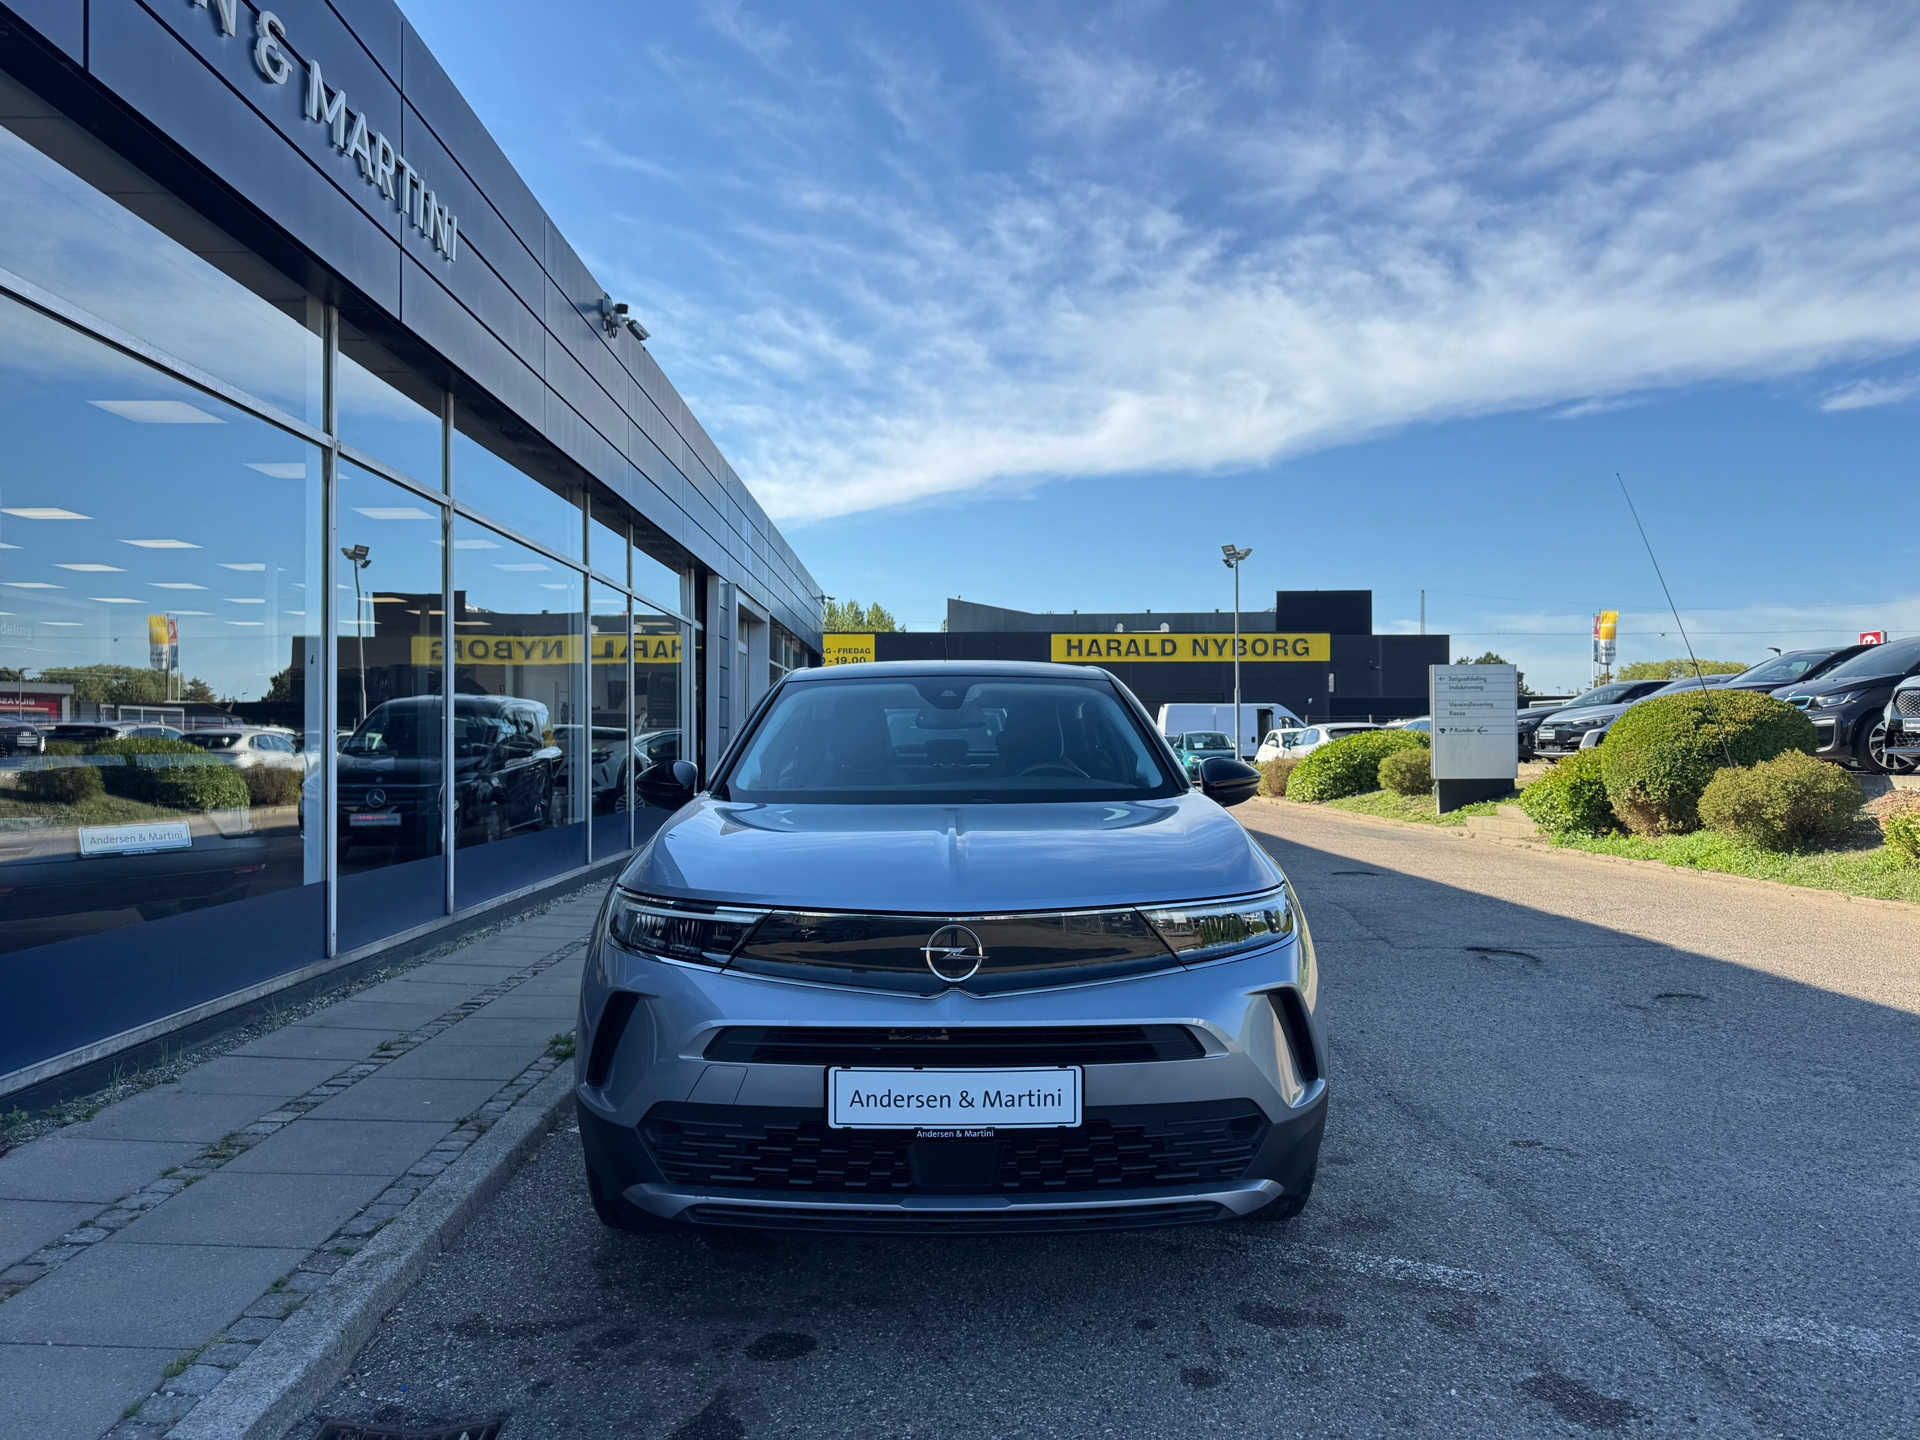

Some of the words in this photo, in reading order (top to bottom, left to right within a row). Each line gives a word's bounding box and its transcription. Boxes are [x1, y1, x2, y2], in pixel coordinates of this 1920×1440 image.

[254, 10, 293, 85] &
[305, 59, 458, 262] MARTINI
[1066, 638, 1177, 657] HARALD
[1192, 638, 1310, 657] NYBORG
[834, 656, 866, 664] 19.00
[1448, 675, 1487, 683] Salgsafdeling
[89, 833, 137, 846] Andersen
[138, 833, 146, 842] &
[148, 830, 183, 841] Martini
[849, 1088, 951, 1109] Andersen
[958, 1090, 975, 1109] &
[982, 1088, 1062, 1108] Martini
[916, 1130, 954, 1138] Andersen
[955, 1130, 962, 1138] &
[964, 1129, 994, 1138] Martini
